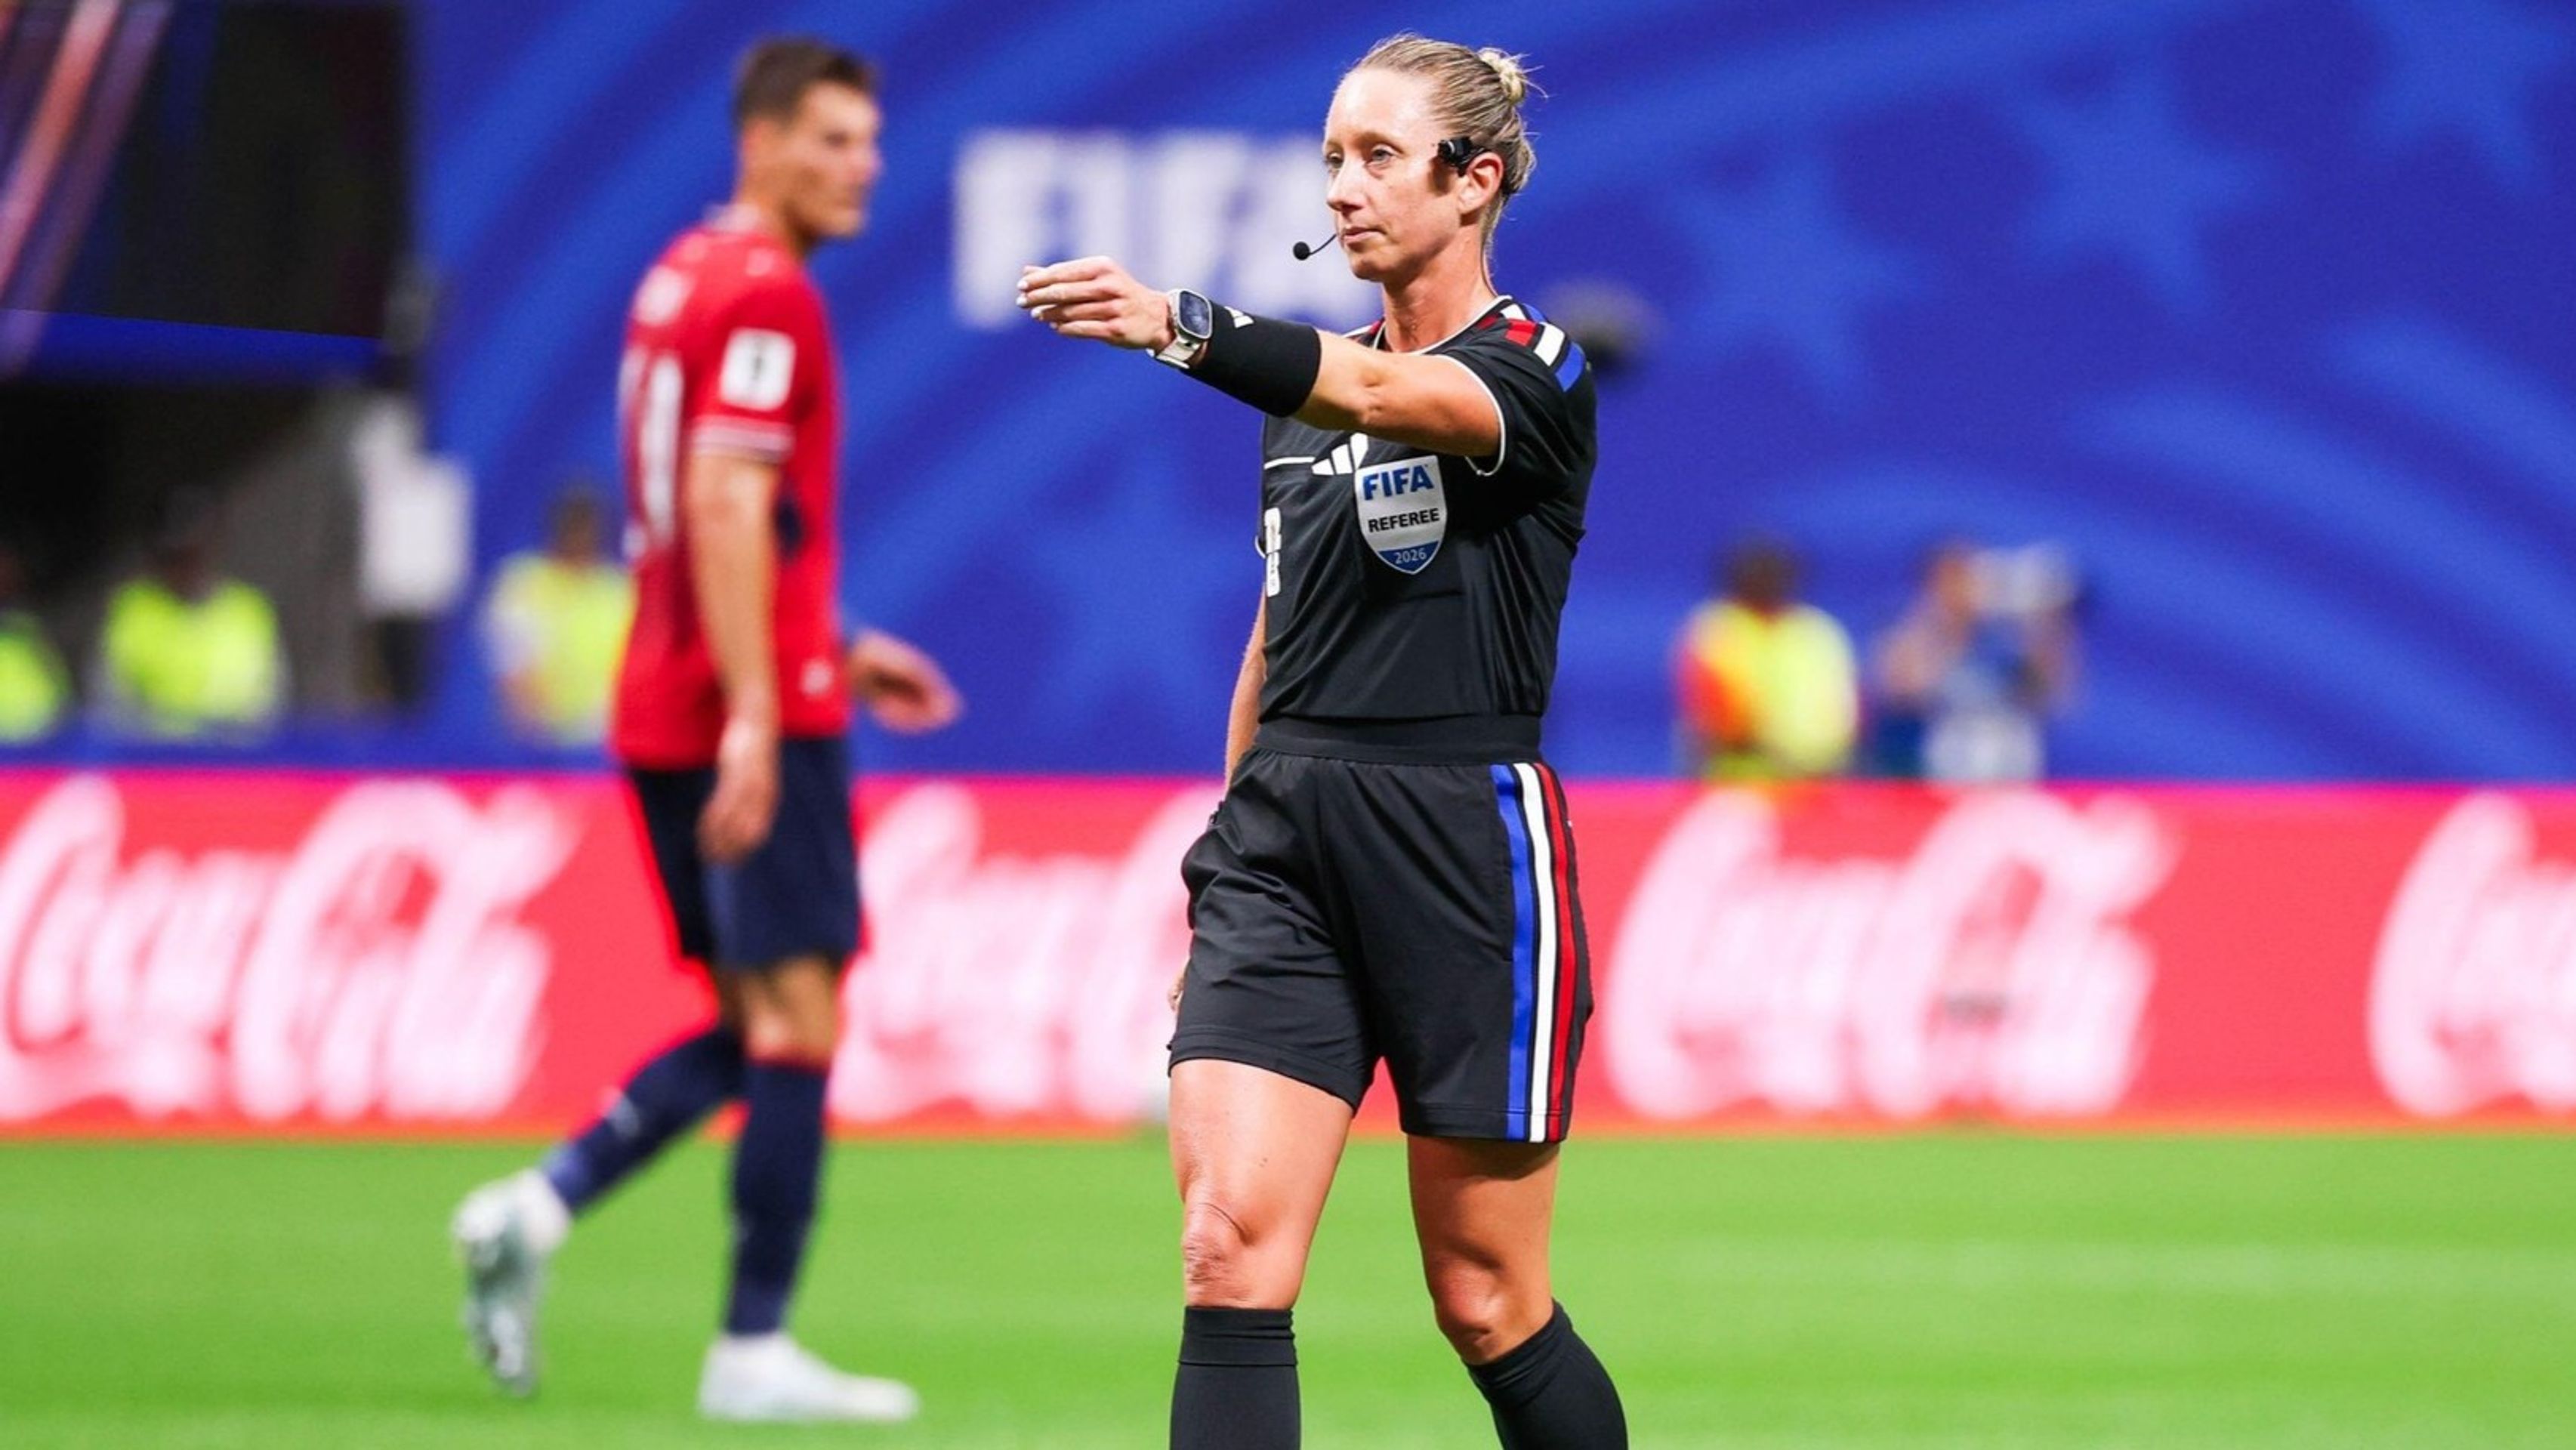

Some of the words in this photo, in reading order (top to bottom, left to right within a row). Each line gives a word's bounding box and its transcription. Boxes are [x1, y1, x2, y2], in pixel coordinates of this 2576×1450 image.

[1363, 464, 1434, 501] FIFA
[1368, 508, 1440, 533] REFEREE
[1394, 547, 1427, 564] 2026
